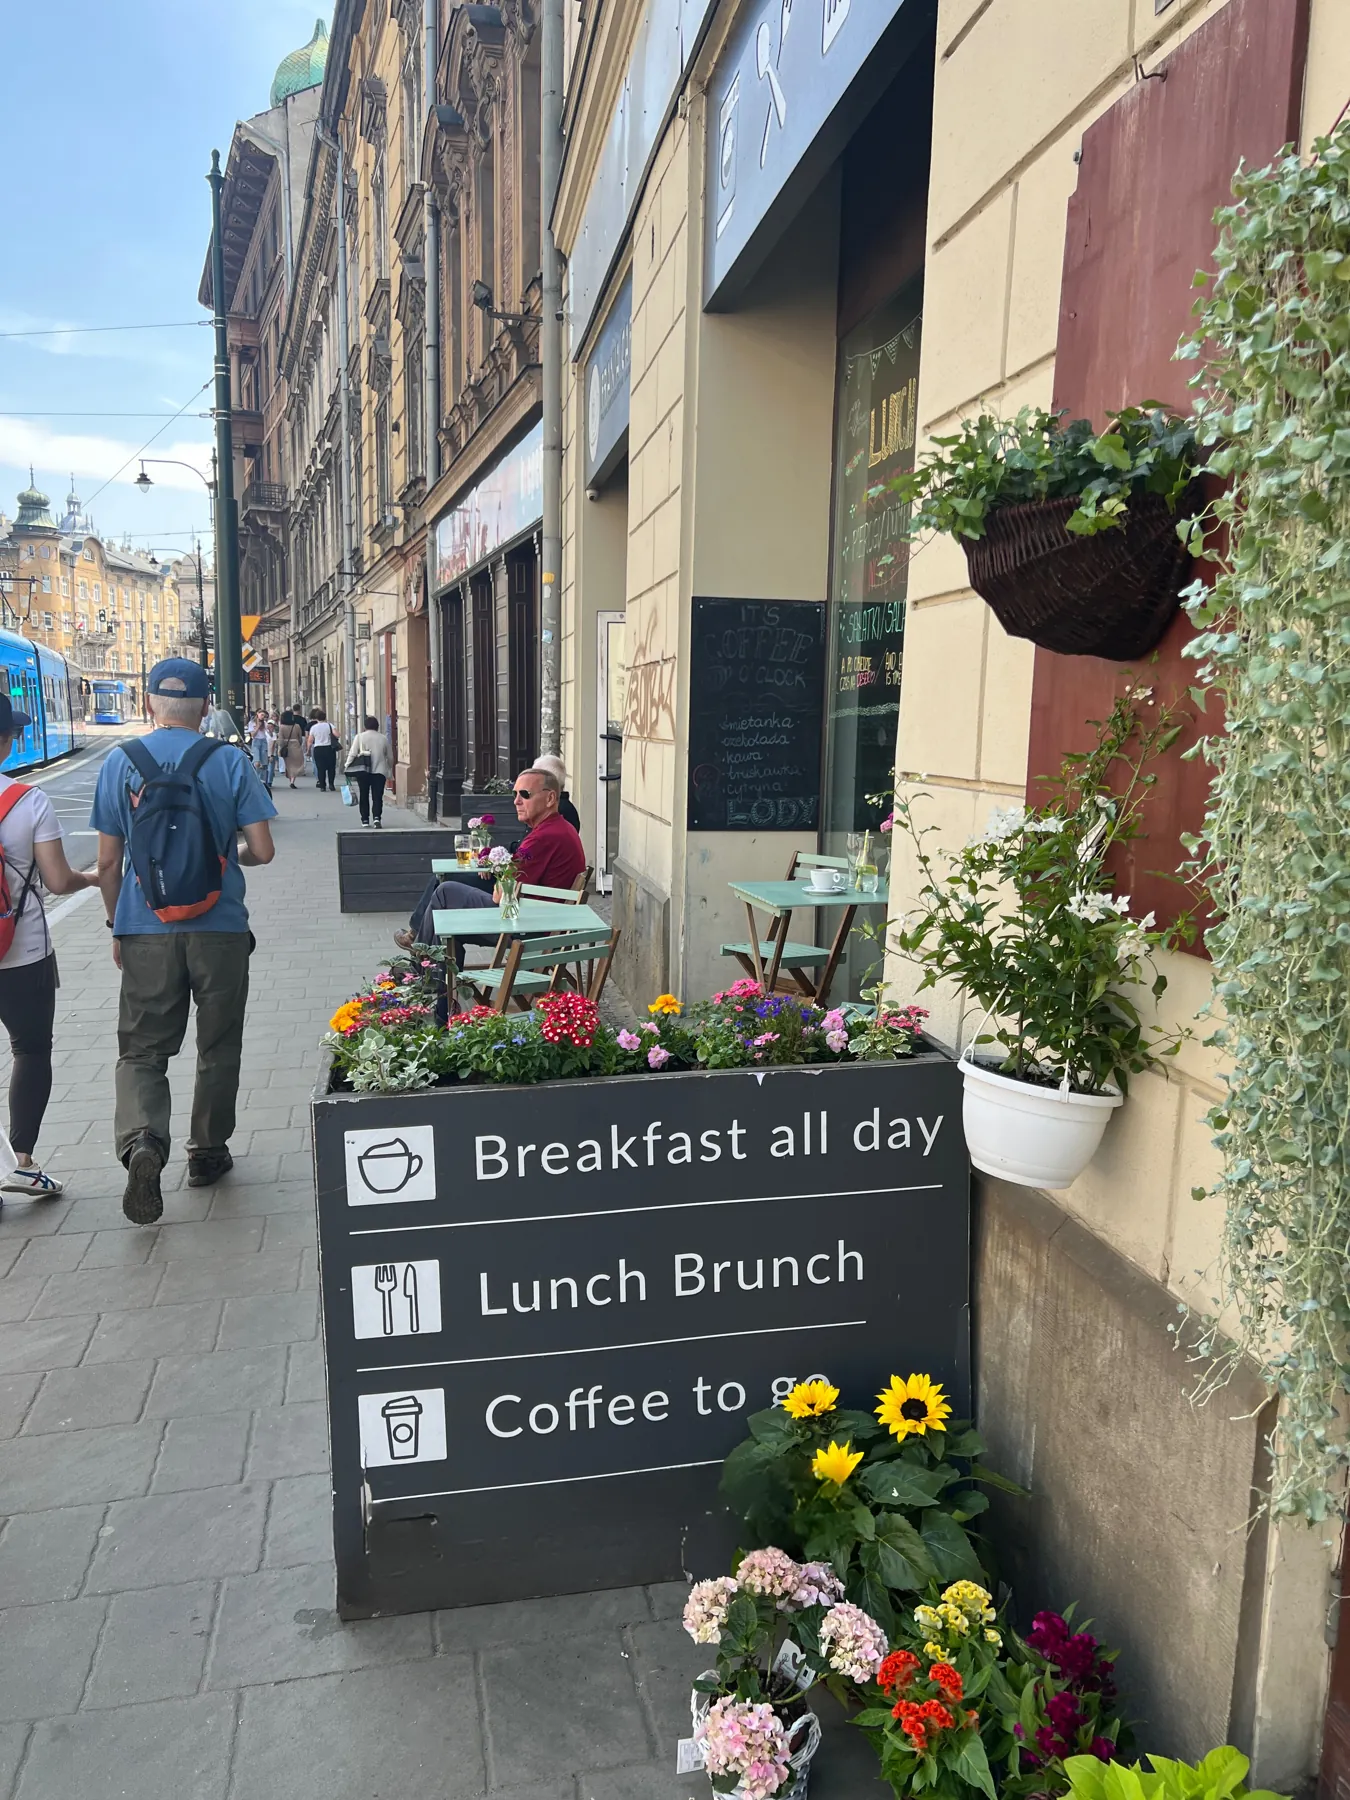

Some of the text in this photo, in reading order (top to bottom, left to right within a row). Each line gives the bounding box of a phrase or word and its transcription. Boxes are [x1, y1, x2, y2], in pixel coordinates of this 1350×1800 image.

[740, 605, 780, 626] IT'S
[726, 750, 764, 765] kawa
[726, 795, 817, 827] LODY
[475, 1107, 944, 1181] Breakfast all day
[479, 1239, 864, 1316] Lunch Brunch
[485, 1384, 669, 1438] Coffee
[692, 1376, 746, 1416] to
